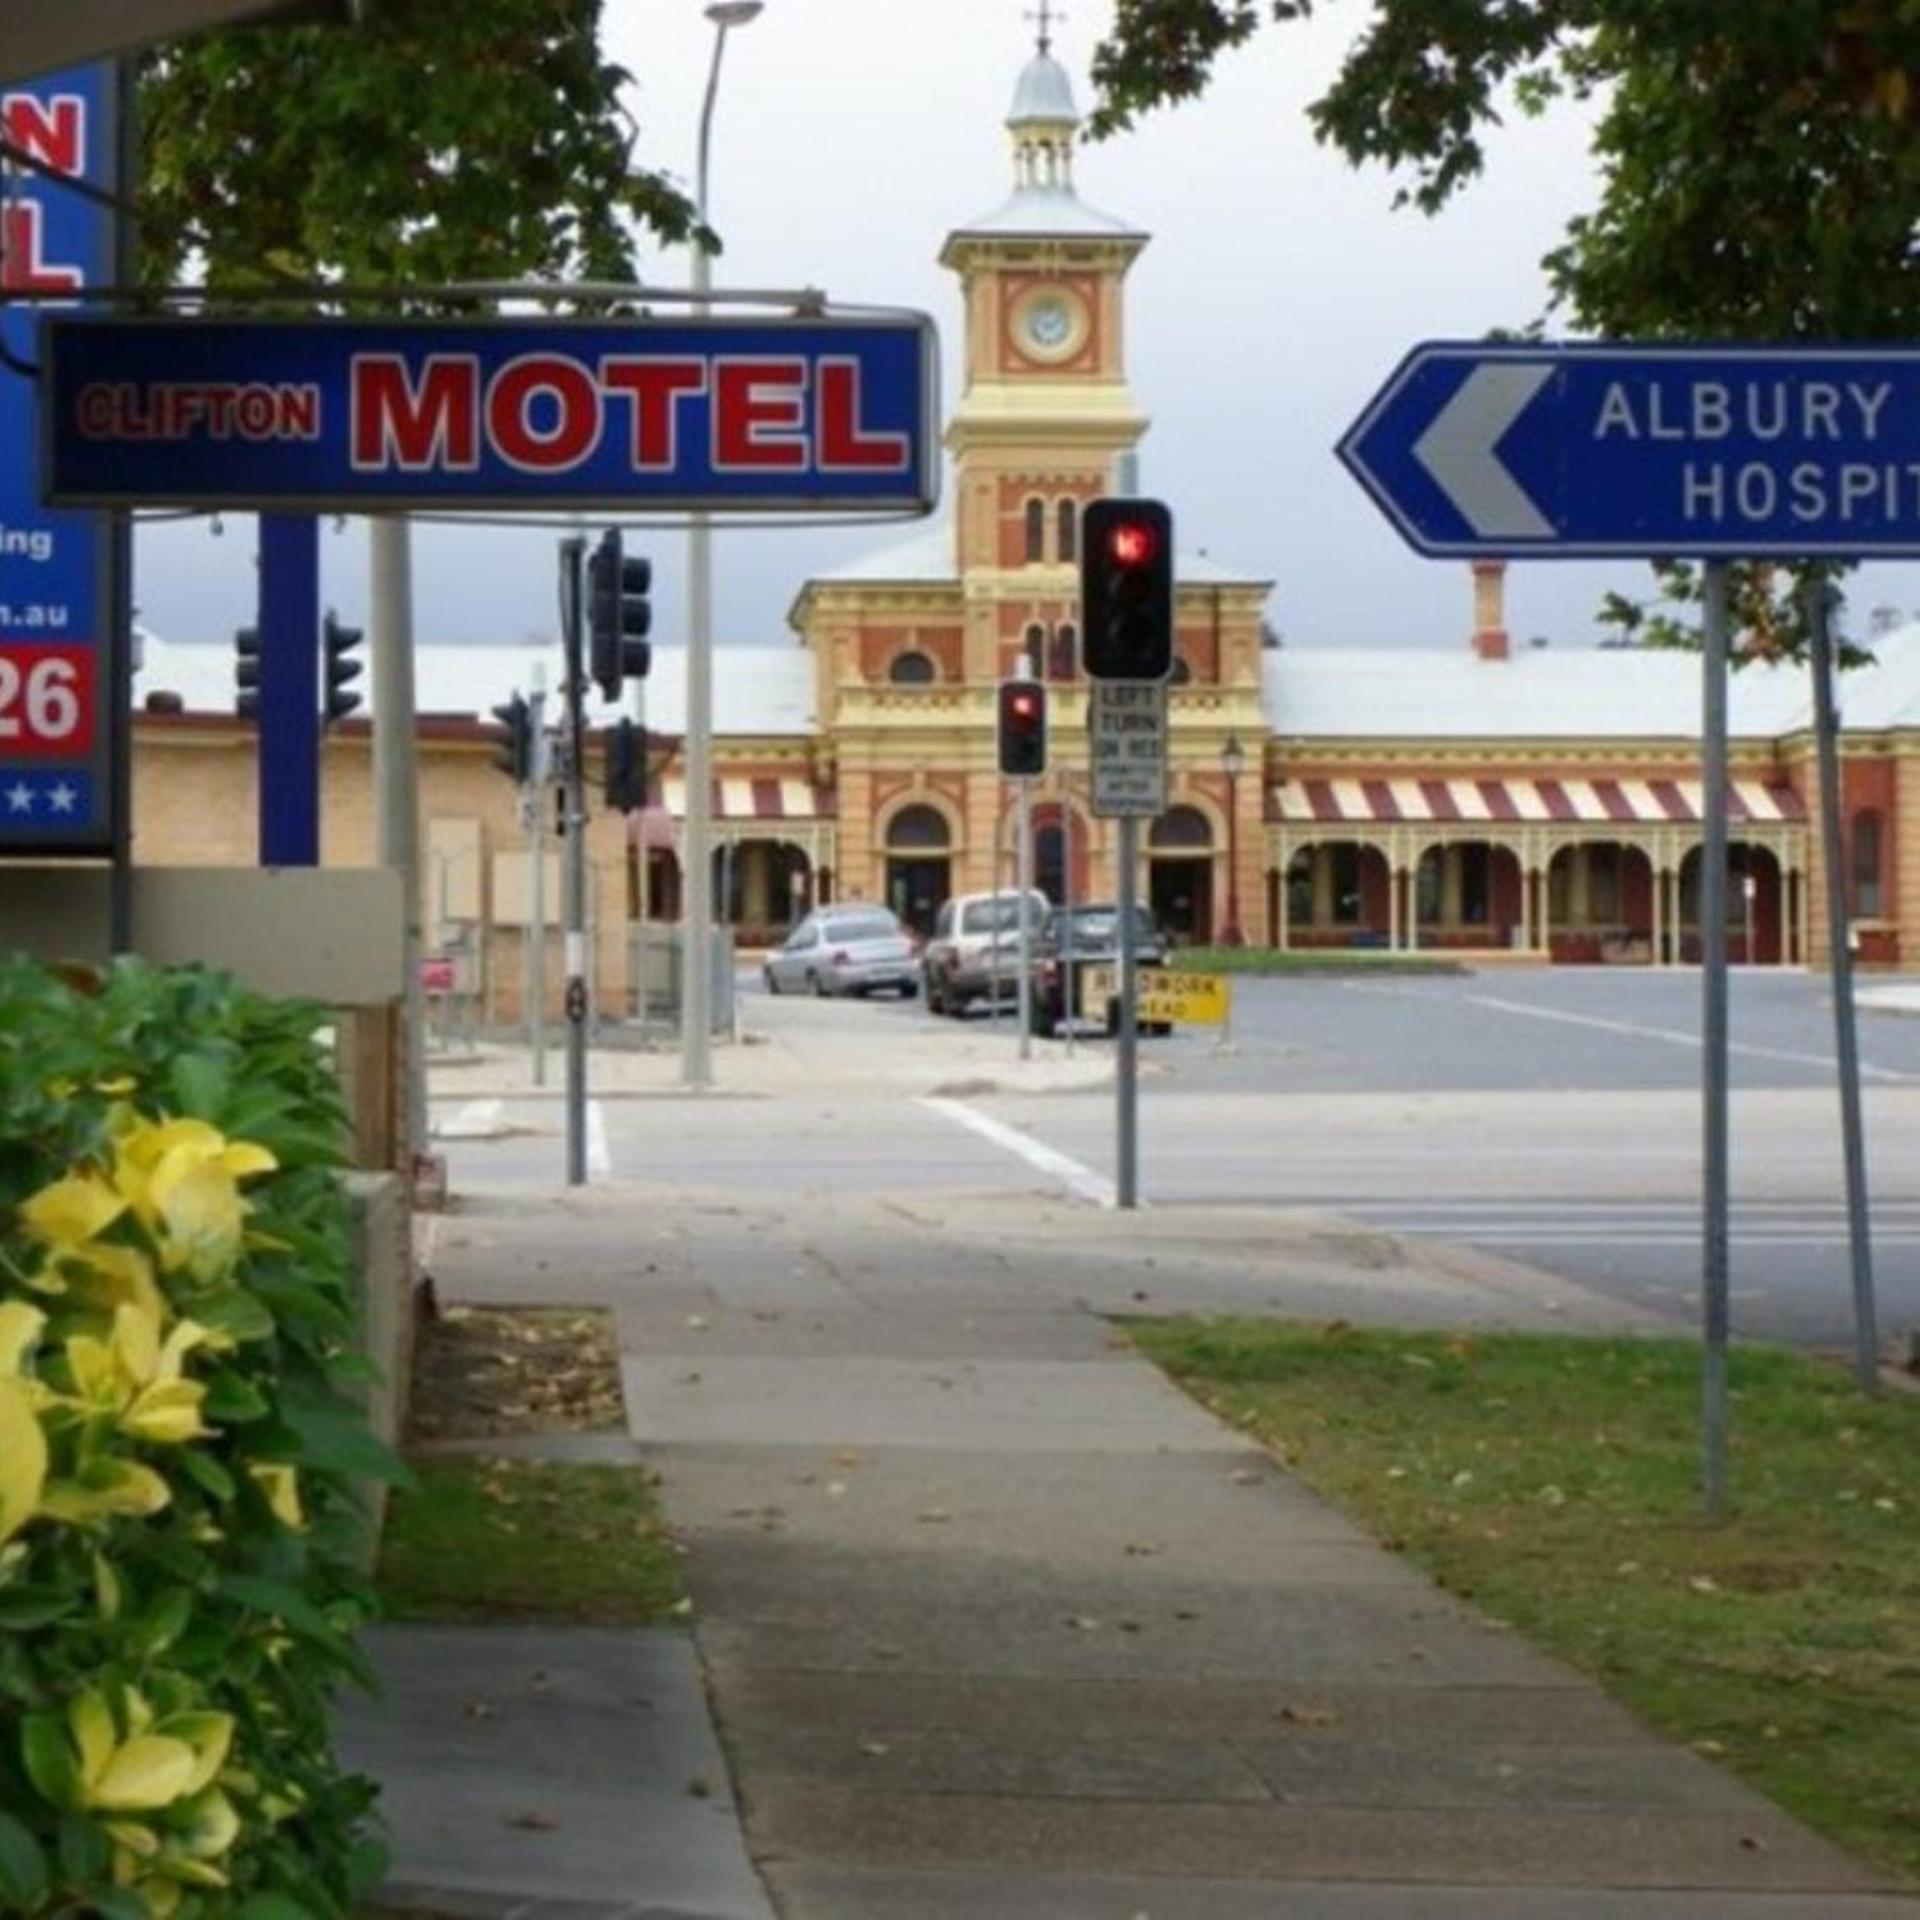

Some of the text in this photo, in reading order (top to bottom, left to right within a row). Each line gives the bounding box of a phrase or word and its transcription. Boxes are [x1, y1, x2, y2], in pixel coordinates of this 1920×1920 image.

[78, 352, 911, 473] CLIFTON MOTEL
[1594, 381, 1893, 440] ALBURY
[1101, 712, 1157, 733] TURN
[1095, 970, 1216, 996] RDWORK
